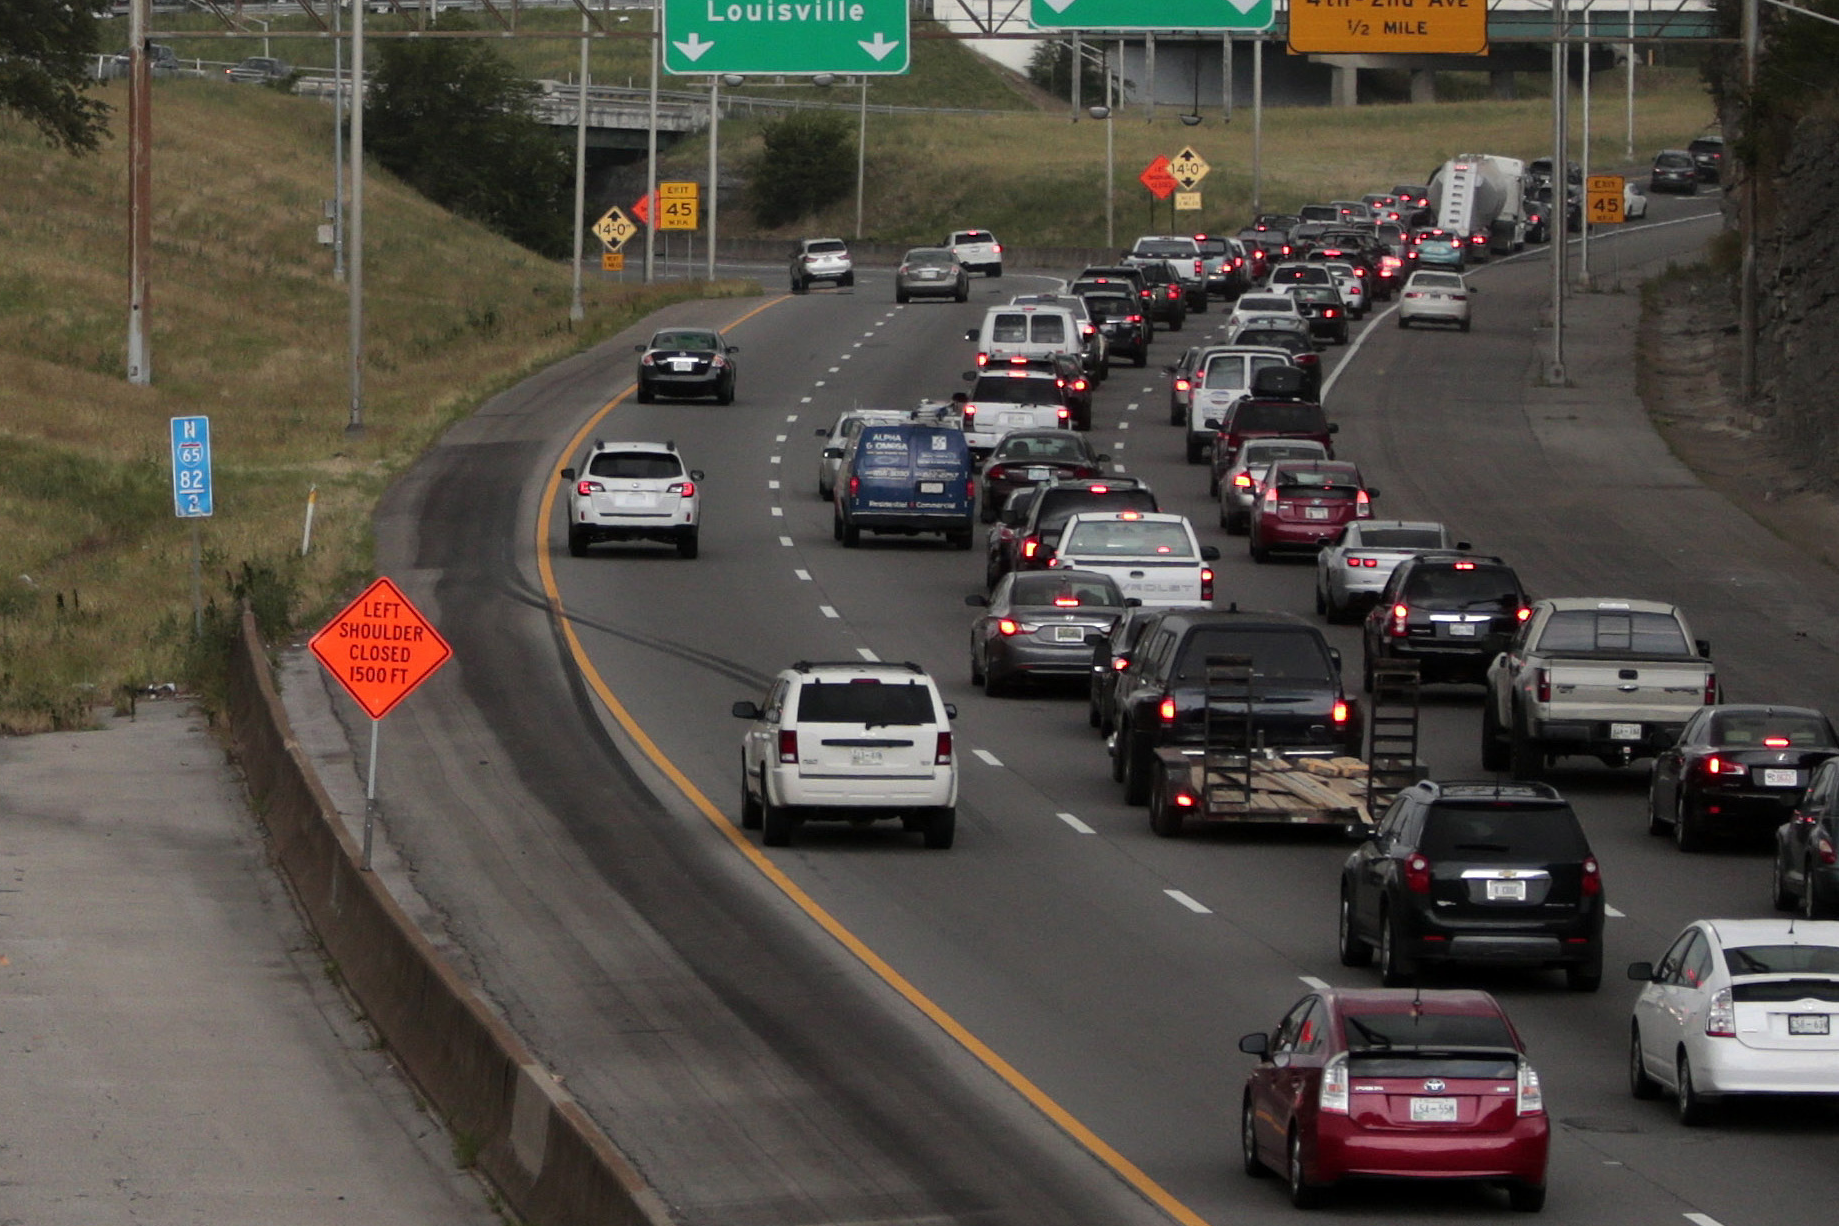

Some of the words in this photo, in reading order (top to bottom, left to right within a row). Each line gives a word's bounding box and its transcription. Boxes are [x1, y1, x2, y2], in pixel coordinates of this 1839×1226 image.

[707, 0, 865, 22] Louisville
[1384, 21, 1428, 35] MILE
[665, 203, 692, 216] 45
[1593, 198, 1619, 213] 45
[184, 420, 195, 439] N
[873, 434, 902, 442] ALPHA
[875, 441, 909, 450] OMEGA
[183, 448, 200, 462] 65
[181, 470, 202, 489] 82
[363, 601, 401, 619] LEFT
[340, 622, 423, 642] SHOULDER
[349, 644, 411, 663] CLOSED
[349, 666, 386, 684] 1500
[390, 668, 409, 685] FT
